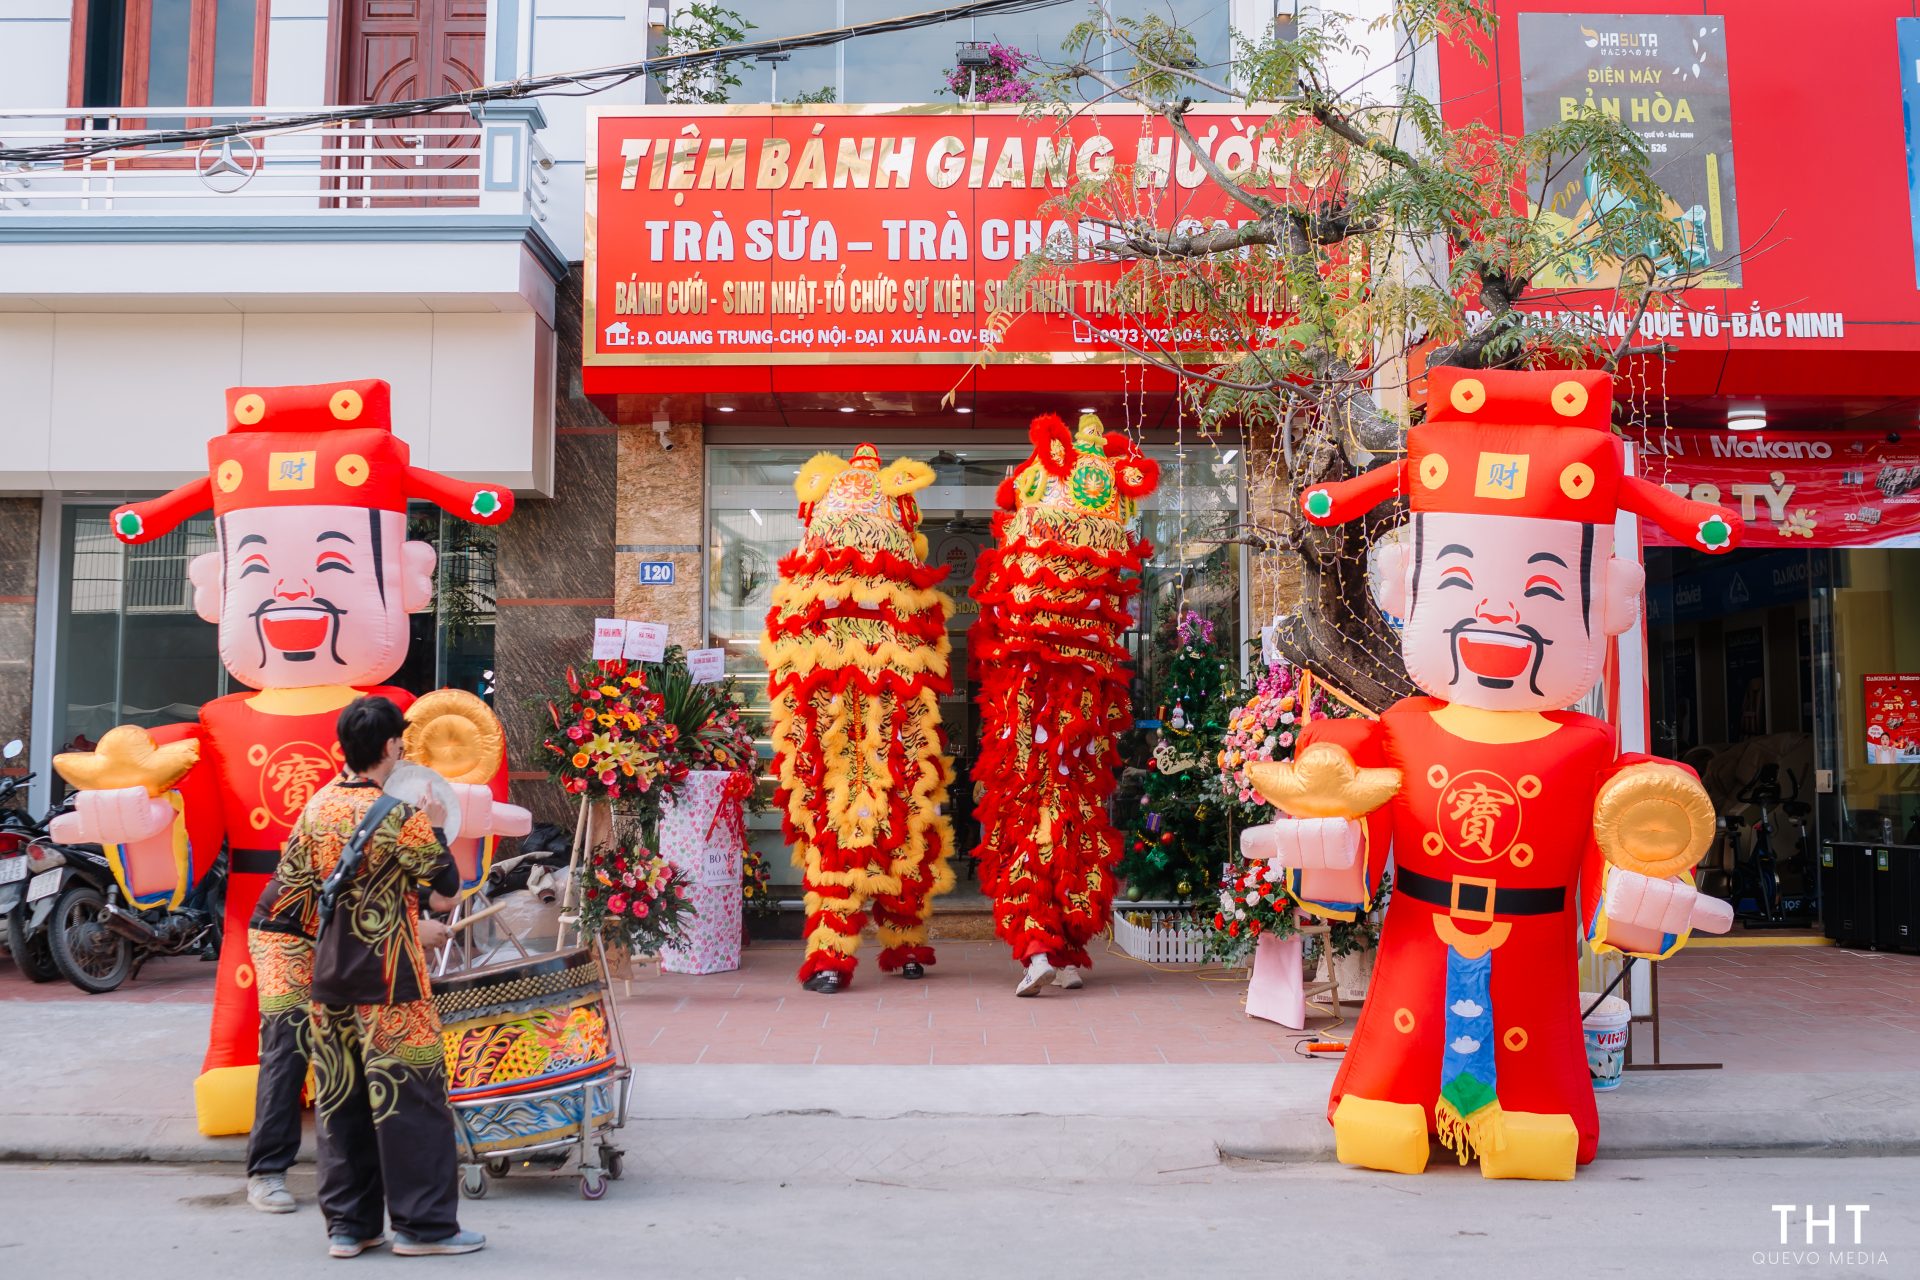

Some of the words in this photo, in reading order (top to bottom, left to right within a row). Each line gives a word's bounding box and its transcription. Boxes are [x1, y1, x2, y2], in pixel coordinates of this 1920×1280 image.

[1600, 33, 1658, 47] HASUTA
[1587, 65, 1625, 87] ĐIỆN
[1630, 66, 1663, 84] MÁY
[1559, 87, 1621, 123] BẢN
[1630, 91, 1695, 123] HÒA
[1651, 143, 1667, 153] 526
[620, 123, 748, 206] TIỆM
[756, 122, 916, 190] BÁNH
[925, 135, 1115, 189] GIANG
[645, 210, 734, 261] TRÀ
[745, 209, 838, 261] SỮA
[882, 210, 968, 261] TRÀ
[615, 272, 663, 315] BÁNH
[667, 271, 708, 314] CƯỚI
[722, 280, 765, 315] SINH
[850, 271, 898, 314] CHỨC
[903, 275, 929, 319] SỰ
[933, 273, 975, 318] KIỆN
[984, 278, 1027, 313] SINH
[1032, 273, 1077, 319] NHẬT
[655, 330, 713, 345] QUANG
[1785, 312, 1844, 338] NINH
[1710, 435, 1833, 459] Makano
[278, 457, 308, 482] 财
[1486, 461, 1520, 491] 财
[1843, 512, 1857, 521] 20
[643, 564, 671, 581] 120
[1446, 781, 1516, 857] 寶
